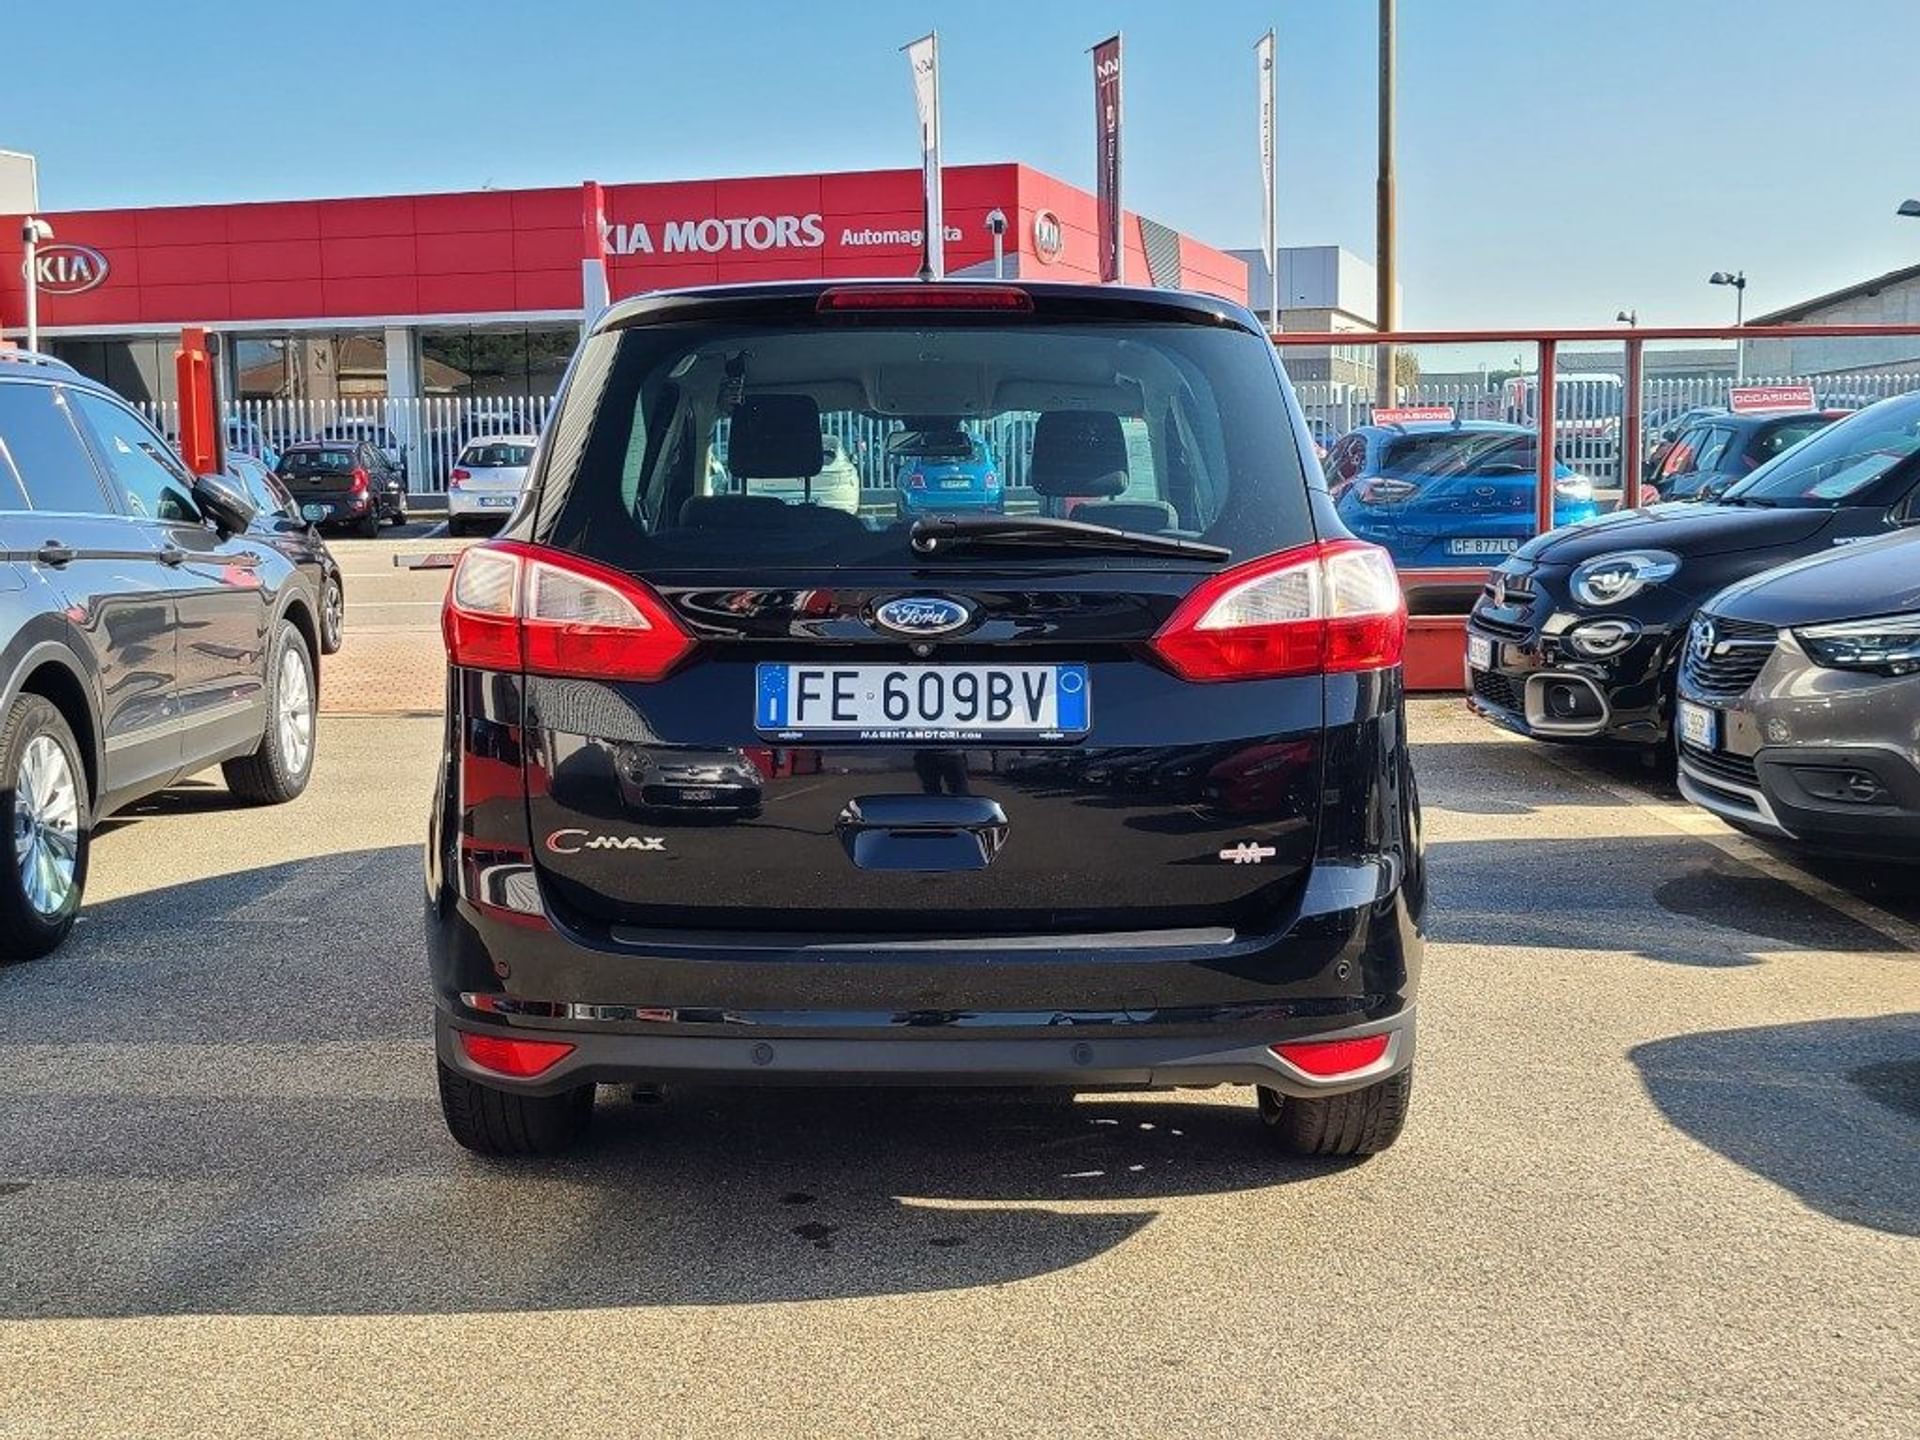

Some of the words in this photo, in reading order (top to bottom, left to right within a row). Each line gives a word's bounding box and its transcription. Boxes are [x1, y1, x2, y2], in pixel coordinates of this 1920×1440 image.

[663, 214, 825, 253] MOTORS
[841, 226, 962, 247] Automagta
[35, 255, 92, 283] KIA
[889, 602, 947, 626] Ford
[796, 671, 860, 721] FE
[883, 671, 1048, 721] 609BV
